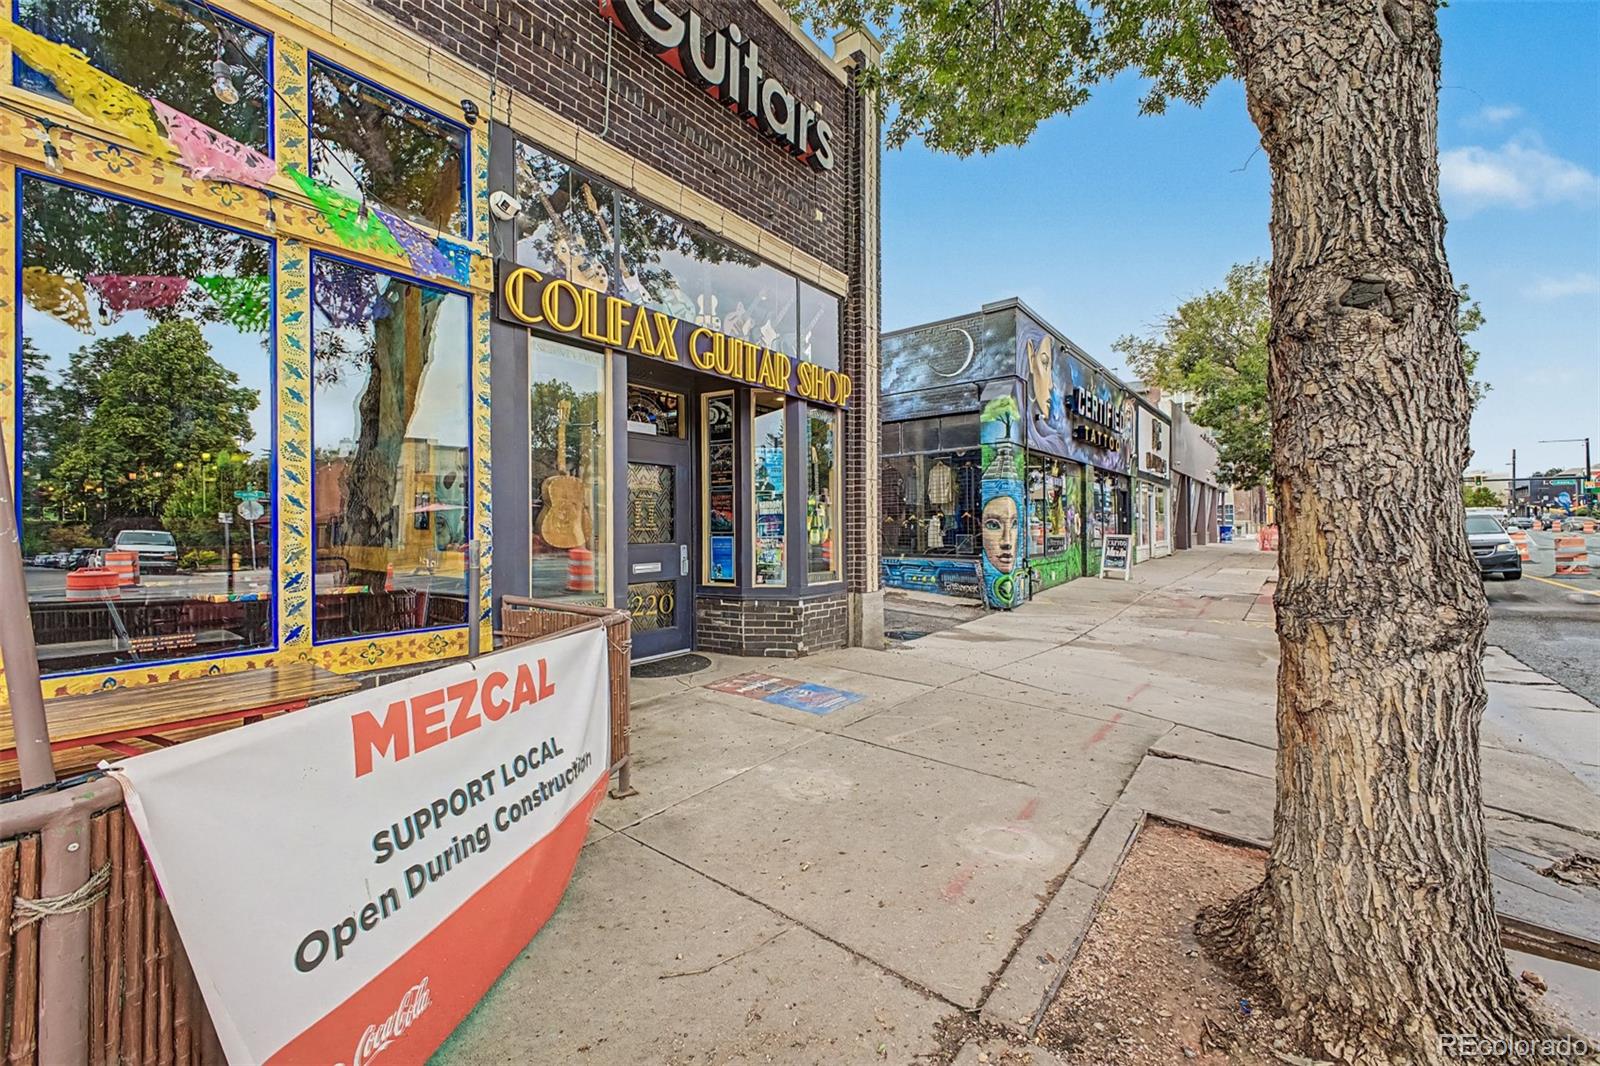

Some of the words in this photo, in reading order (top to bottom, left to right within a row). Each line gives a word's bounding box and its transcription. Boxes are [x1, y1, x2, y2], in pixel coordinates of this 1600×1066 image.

[620, 0, 835, 170] Guitars
[505, 267, 679, 362] COLFAX
[689, 328, 791, 392] GUITAR
[797, 362, 852, 406] SHOP
[1078, 386, 1124, 433] CERTIFIED
[1084, 425, 1120, 452] TATTOO
[632, 593, 674, 617] 220
[351, 658, 556, 778] MEZCAL
[294, 886, 401, 973] Open
[404, 823, 492, 899] During
[495, 750, 593, 832] Construction
[373, 769, 496, 864] SUPPORT
[501, 737, 564, 788] LOCAL
